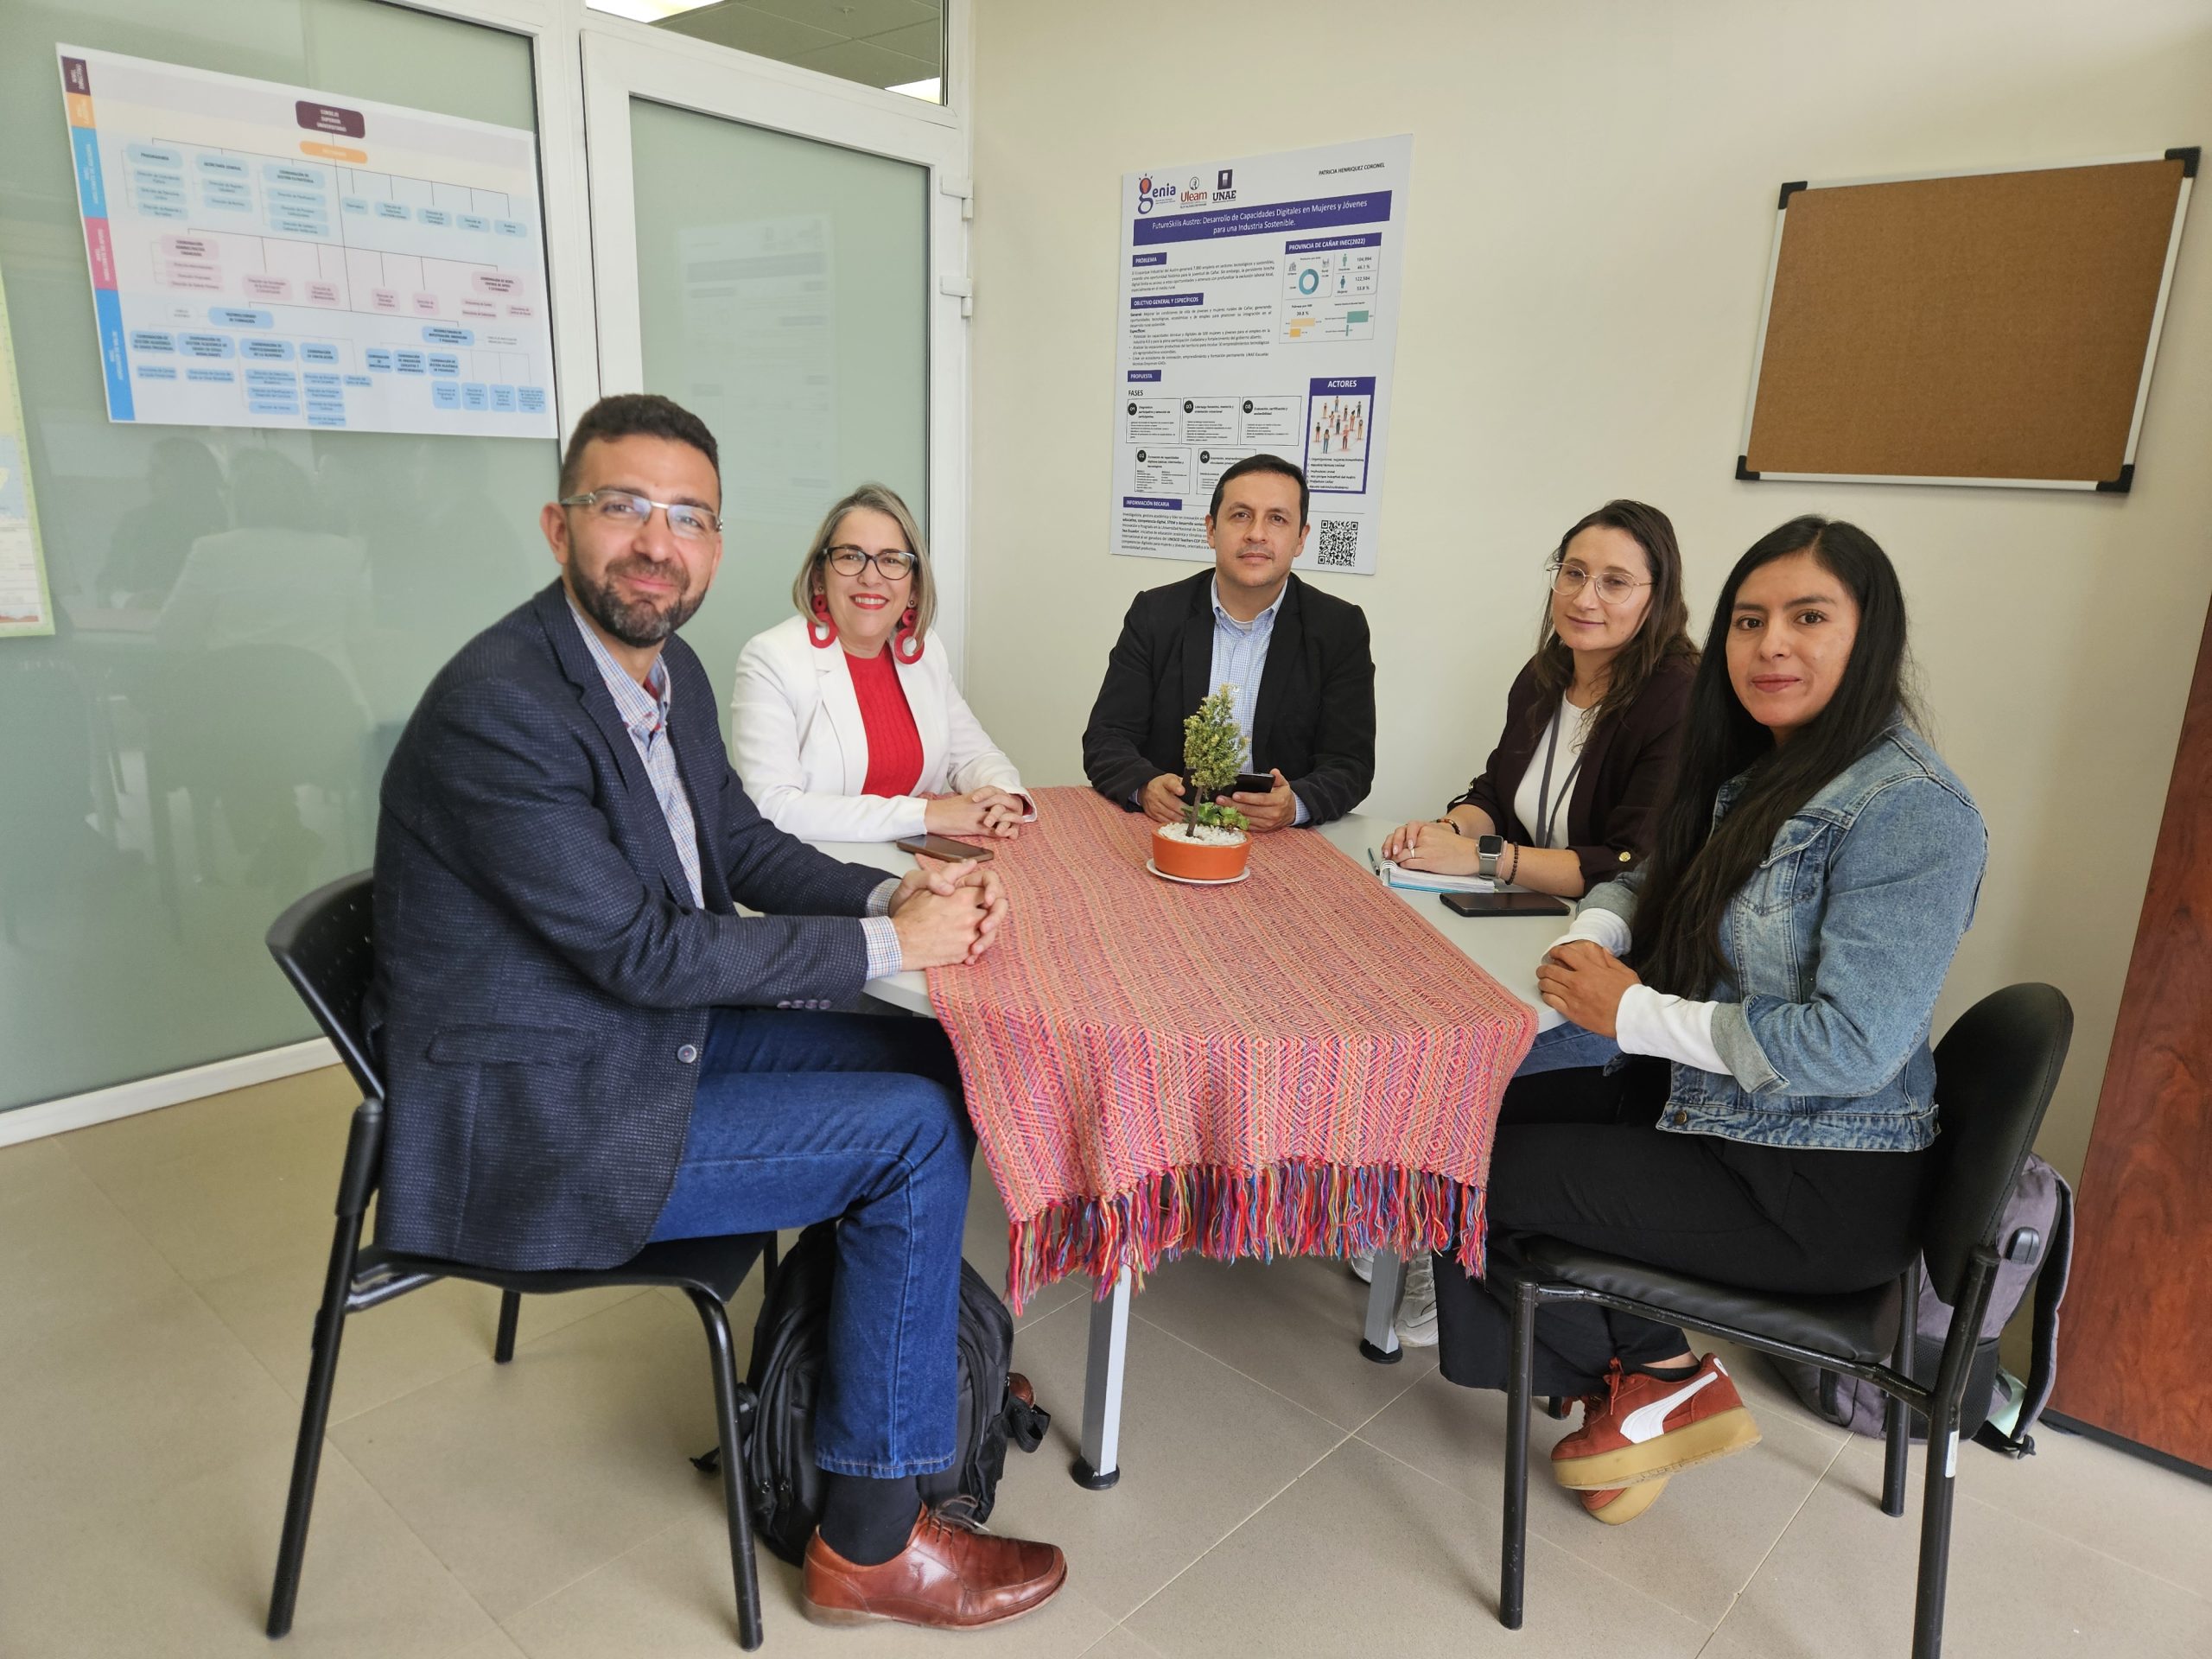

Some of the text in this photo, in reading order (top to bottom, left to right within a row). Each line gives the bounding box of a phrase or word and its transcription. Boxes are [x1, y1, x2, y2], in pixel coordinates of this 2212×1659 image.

[1338, 165, 1363, 174] HENRIQUEZ
[1138, 177, 1176, 214] genia
[1180, 191, 1208, 202] Uleam
[1212, 190, 1236, 201] UNAE
[1153, 219, 1181, 229] FutureSkills
[1203, 214, 1230, 224] Desarrollo
[1239, 210, 1274, 220] Capacidades
[1276, 206, 1301, 217] Digitales
[1312, 202, 1337, 213] Mujeres
[1342, 200, 1368, 209] Jóvenes
[1213, 226, 1226, 235] para
[1238, 220, 1263, 232] Industria
[1264, 219, 1296, 229] Sostenible.
[1322, 239, 1339, 248] CAÑAR
[1339, 238, 1366, 246] INEC(2022)
[1327, 379, 1357, 388] ACTORES
